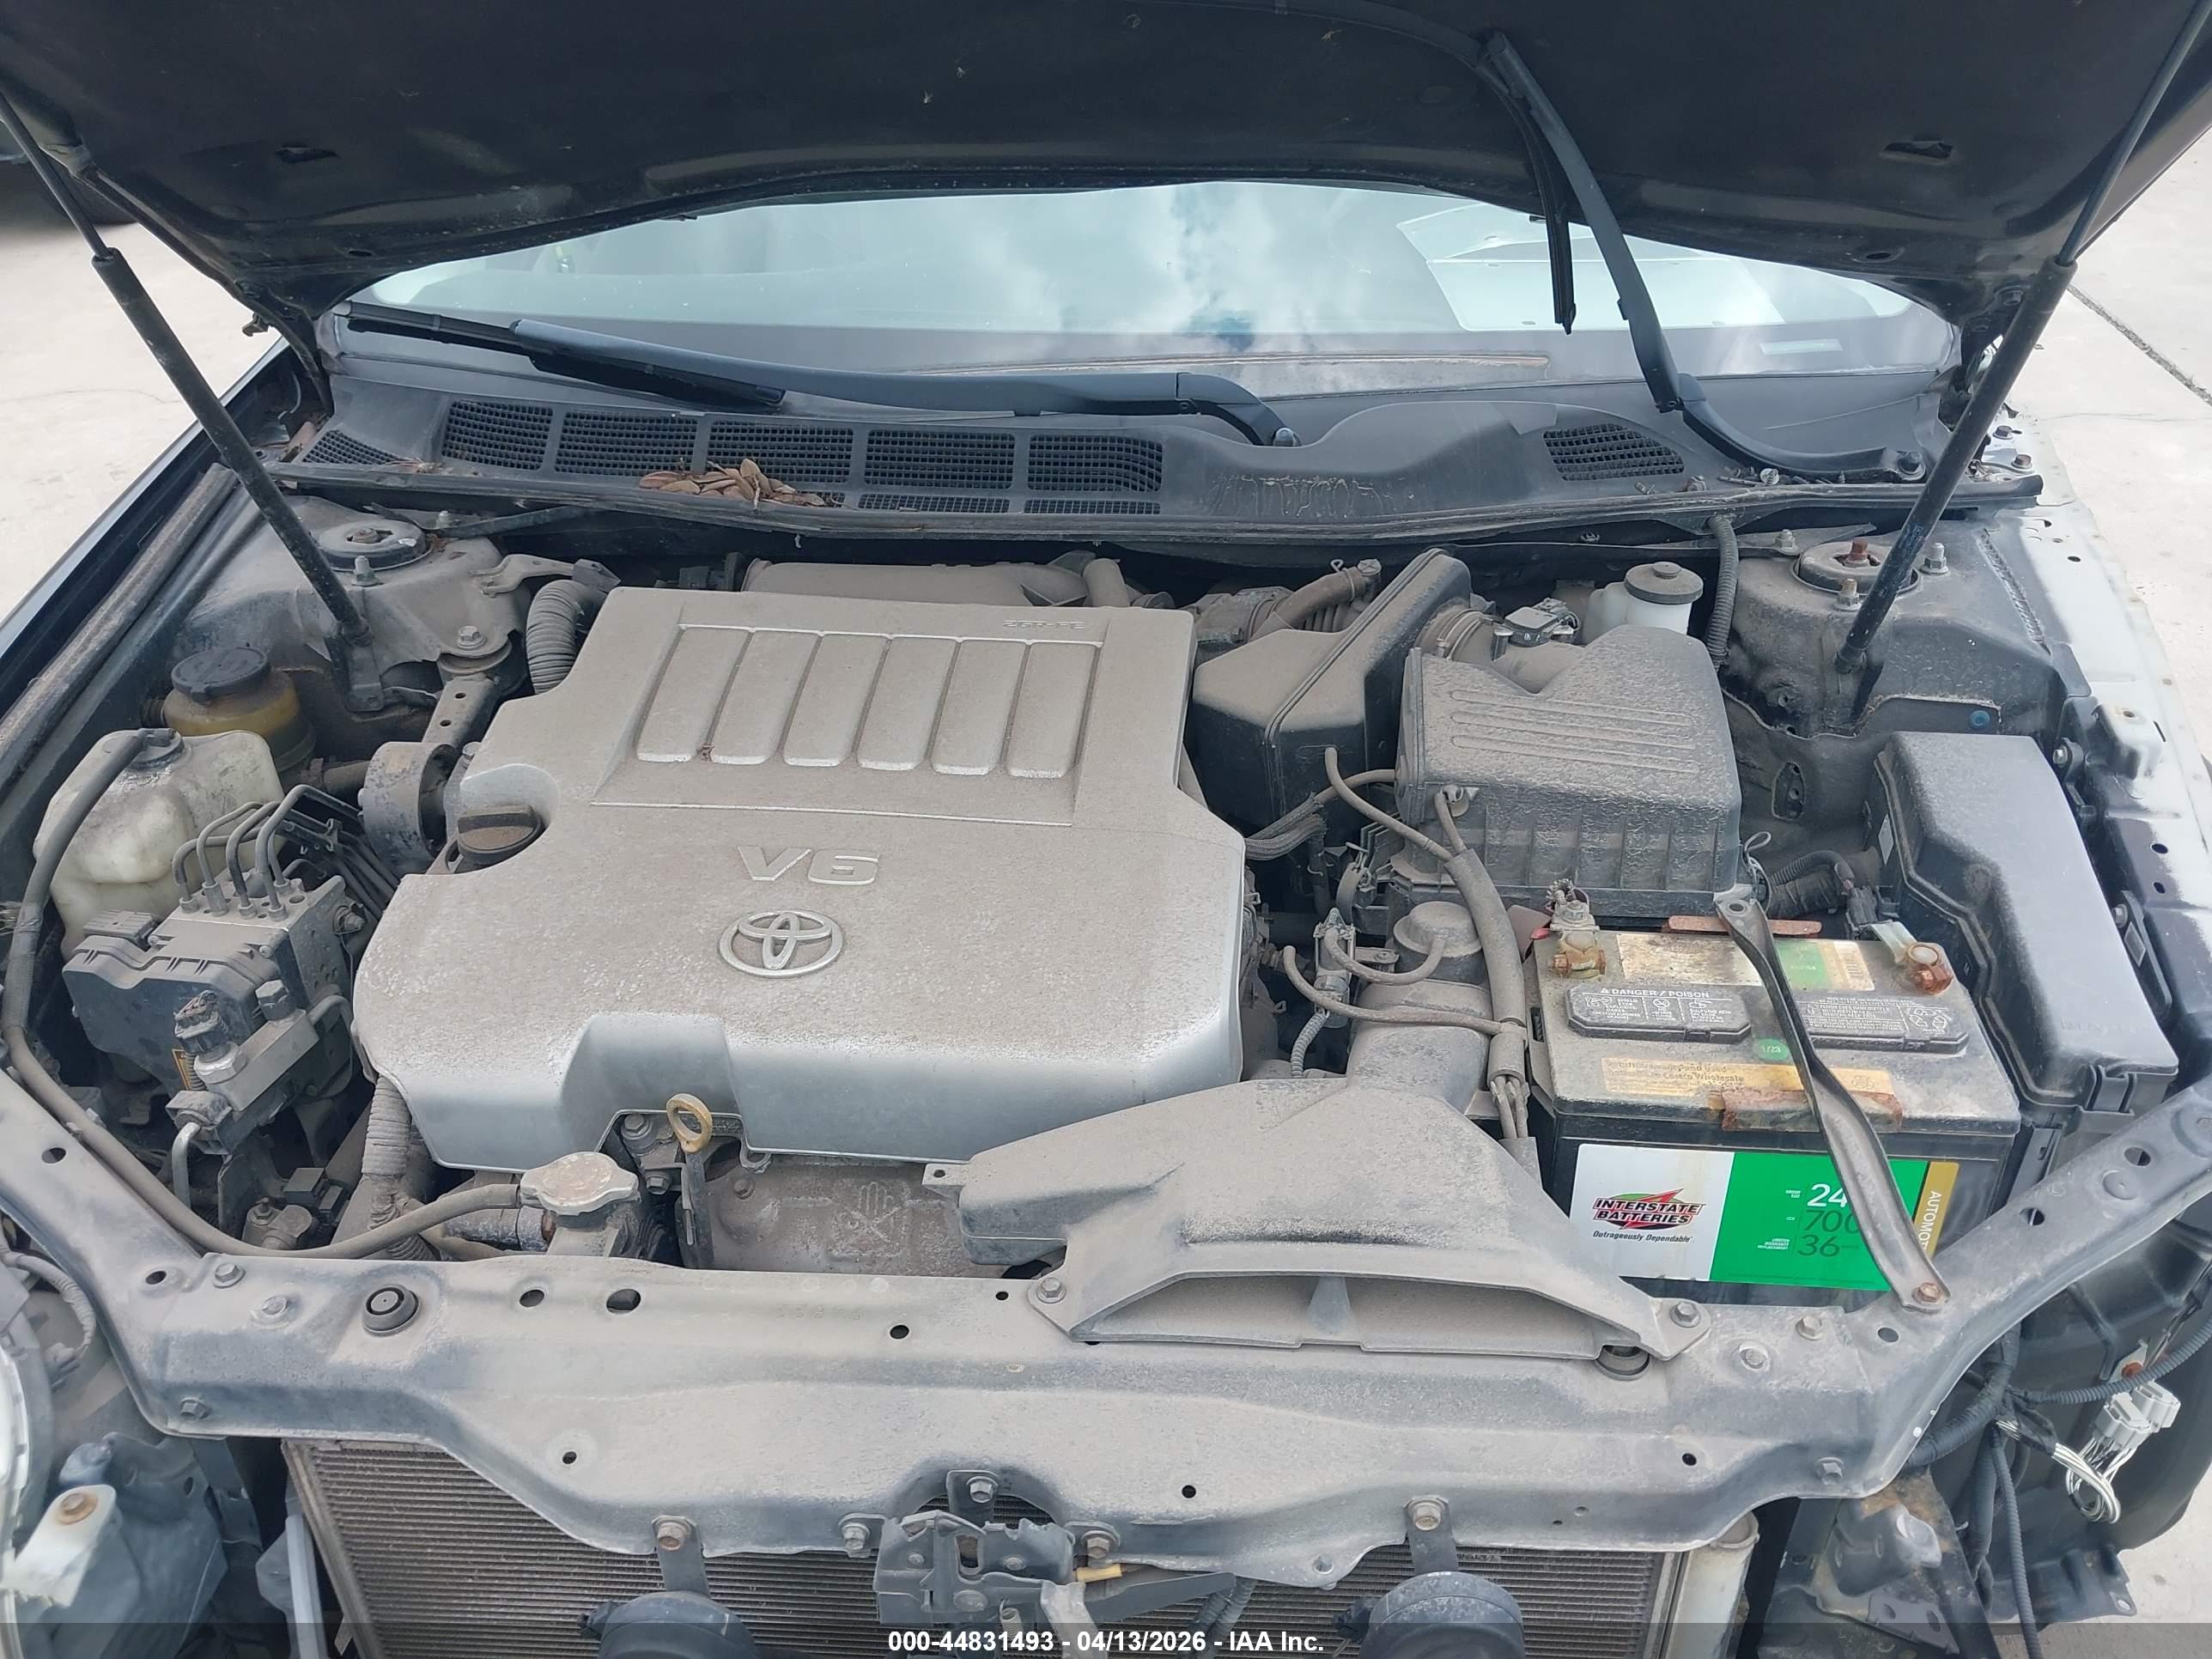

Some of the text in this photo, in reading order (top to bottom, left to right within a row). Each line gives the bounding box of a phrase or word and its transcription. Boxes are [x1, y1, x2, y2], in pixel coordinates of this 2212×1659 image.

[737, 845, 880, 886] V6
[1611, 988, 1657, 997] DANGER
[1668, 990, 1710, 999] POISON
[1595, 1200, 1700, 1214] INTERSTATE
[1597, 1211, 1690, 1224] BATTERIES
[1917, 1190, 1942, 1249] AUTOMOT
[1593, 1230, 1644, 1242] Outrageously
[1797, 1234, 1840, 1257] 36
